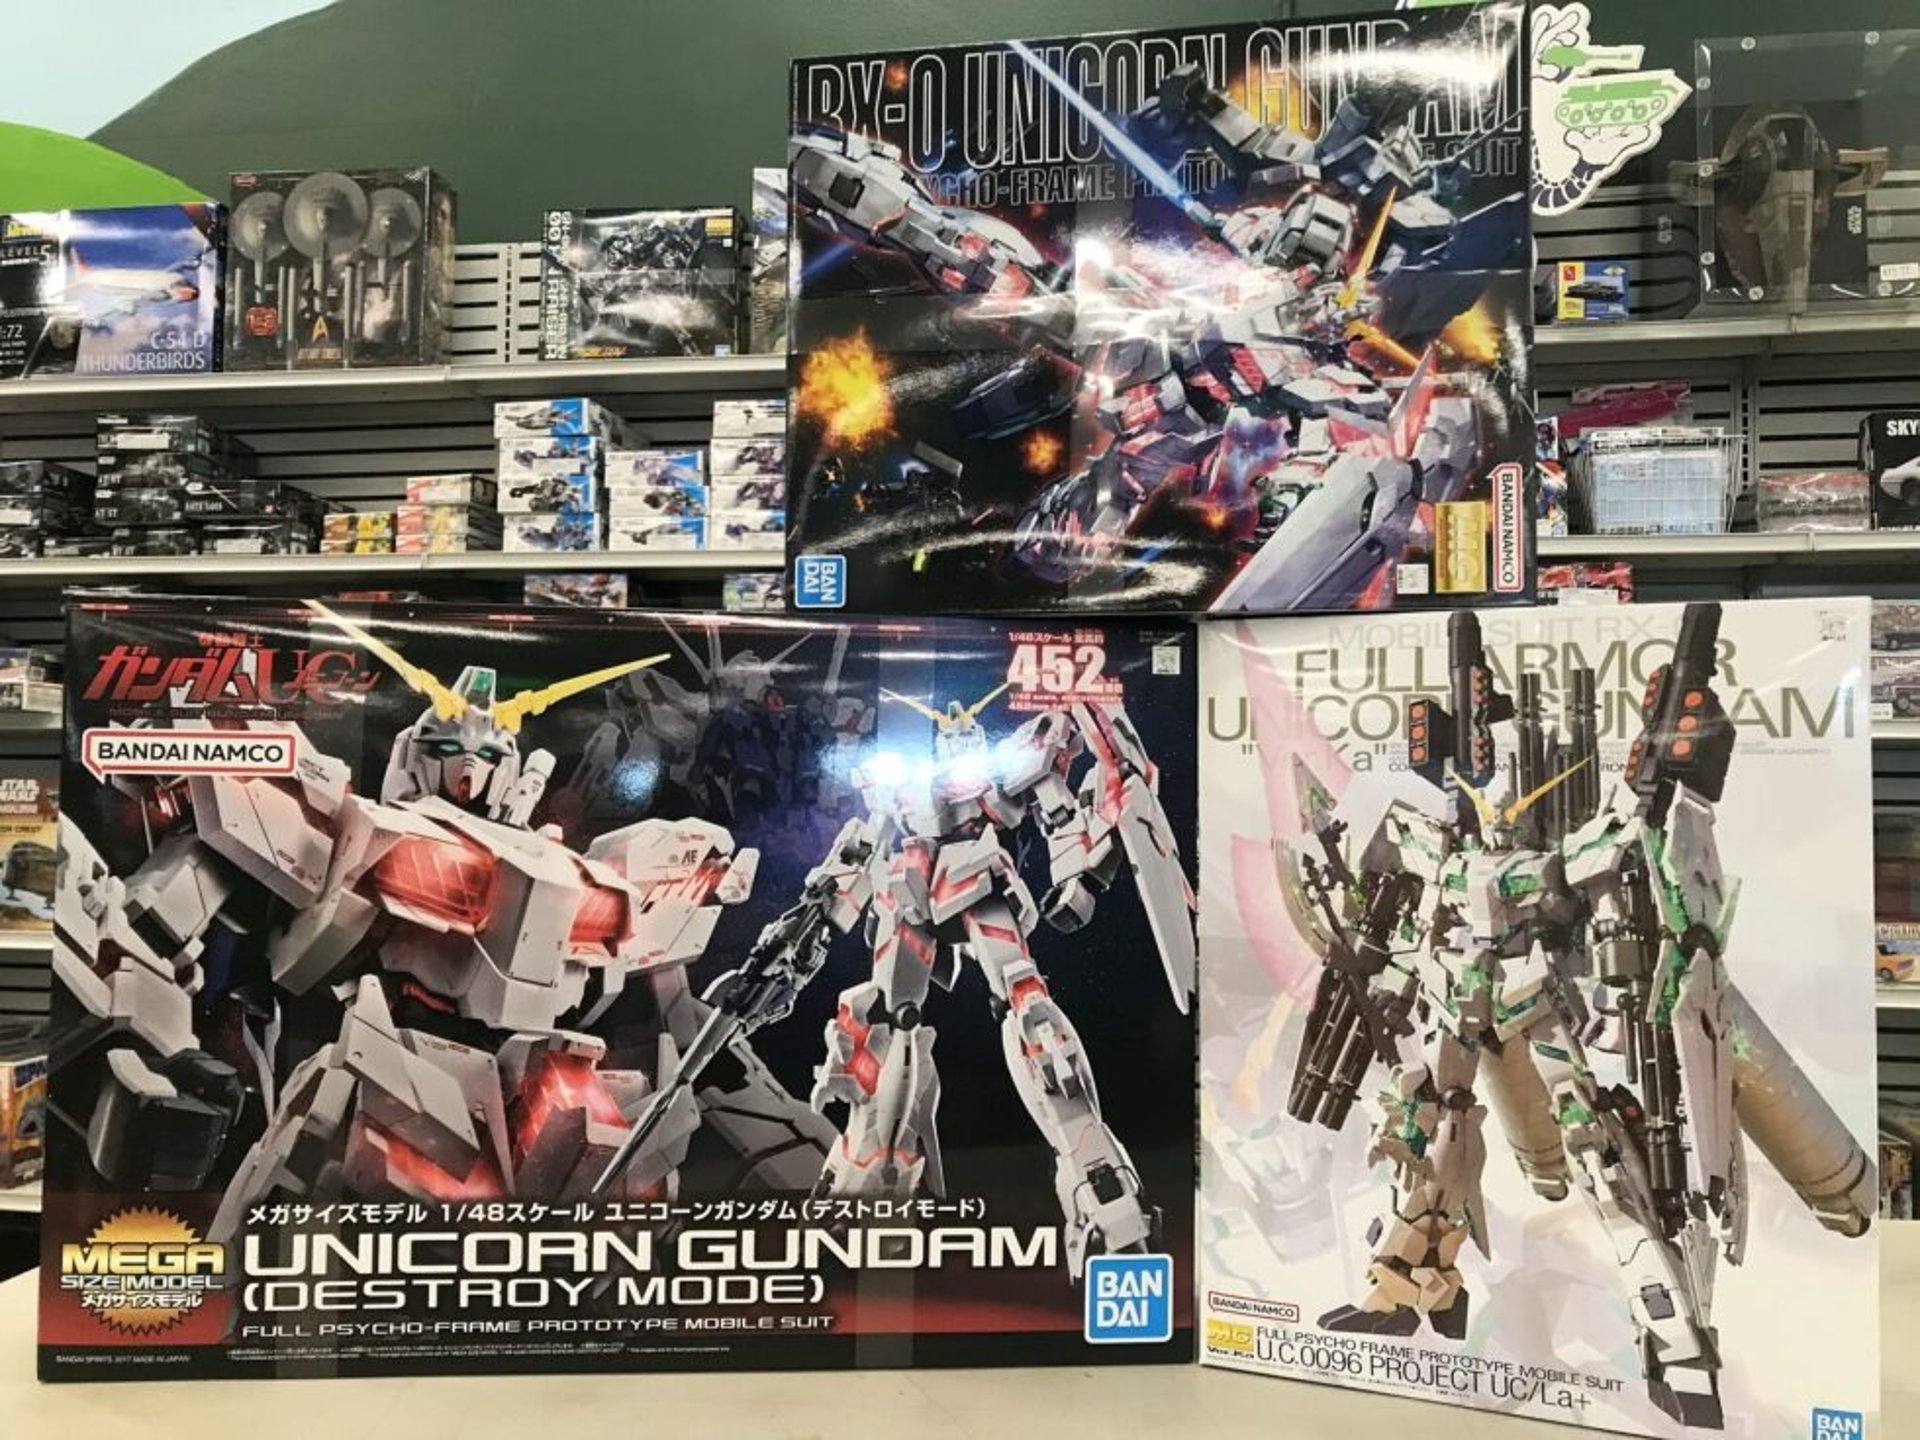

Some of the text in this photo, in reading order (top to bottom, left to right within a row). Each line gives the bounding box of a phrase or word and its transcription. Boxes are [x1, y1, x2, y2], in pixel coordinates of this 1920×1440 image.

[1501, 473, 1516, 584] BANDAI NAMCO
[804, 561, 820, 595] DAI
[821, 561, 839, 603] BAN
[1006, 644, 1106, 694] 452
[1295, 646, 1451, 693] FULL
[97, 741, 284, 765] BANDAI NAMCO
[246, 1197, 987, 1226] メガサイズモデル 1/48スケール ユニコーンガンダム（デストロイモード）
[61, 1242, 226, 1275] MEGA
[243, 1226, 1057, 1277] UNICORN GUNDAM
[60, 1273, 225, 1291] SIZE MODEL
[243, 1273, 825, 1312] (DESTROY MODE)
[1096, 1269, 1164, 1299] BAN
[81, 1290, 204, 1309] メガサイズモデル
[1096, 1299, 1150, 1328] DAI
[1252, 1303, 1294, 1319] NAMCO
[242, 1316, 834, 1339] FULL PSYCHO-FRAME PROTOTYPE MOBILE SUIT
[1256, 1325, 1625, 1393] FULL PSYCHO FRAME PROTOTYPE MOBILE SUIT
[1256, 1339, 1363, 1376] U.C.0096
[1370, 1352, 1484, 1394] PROJECT
[1491, 1375, 1592, 1411] UC/La+
[1817, 1413, 1859, 1434] BAN
